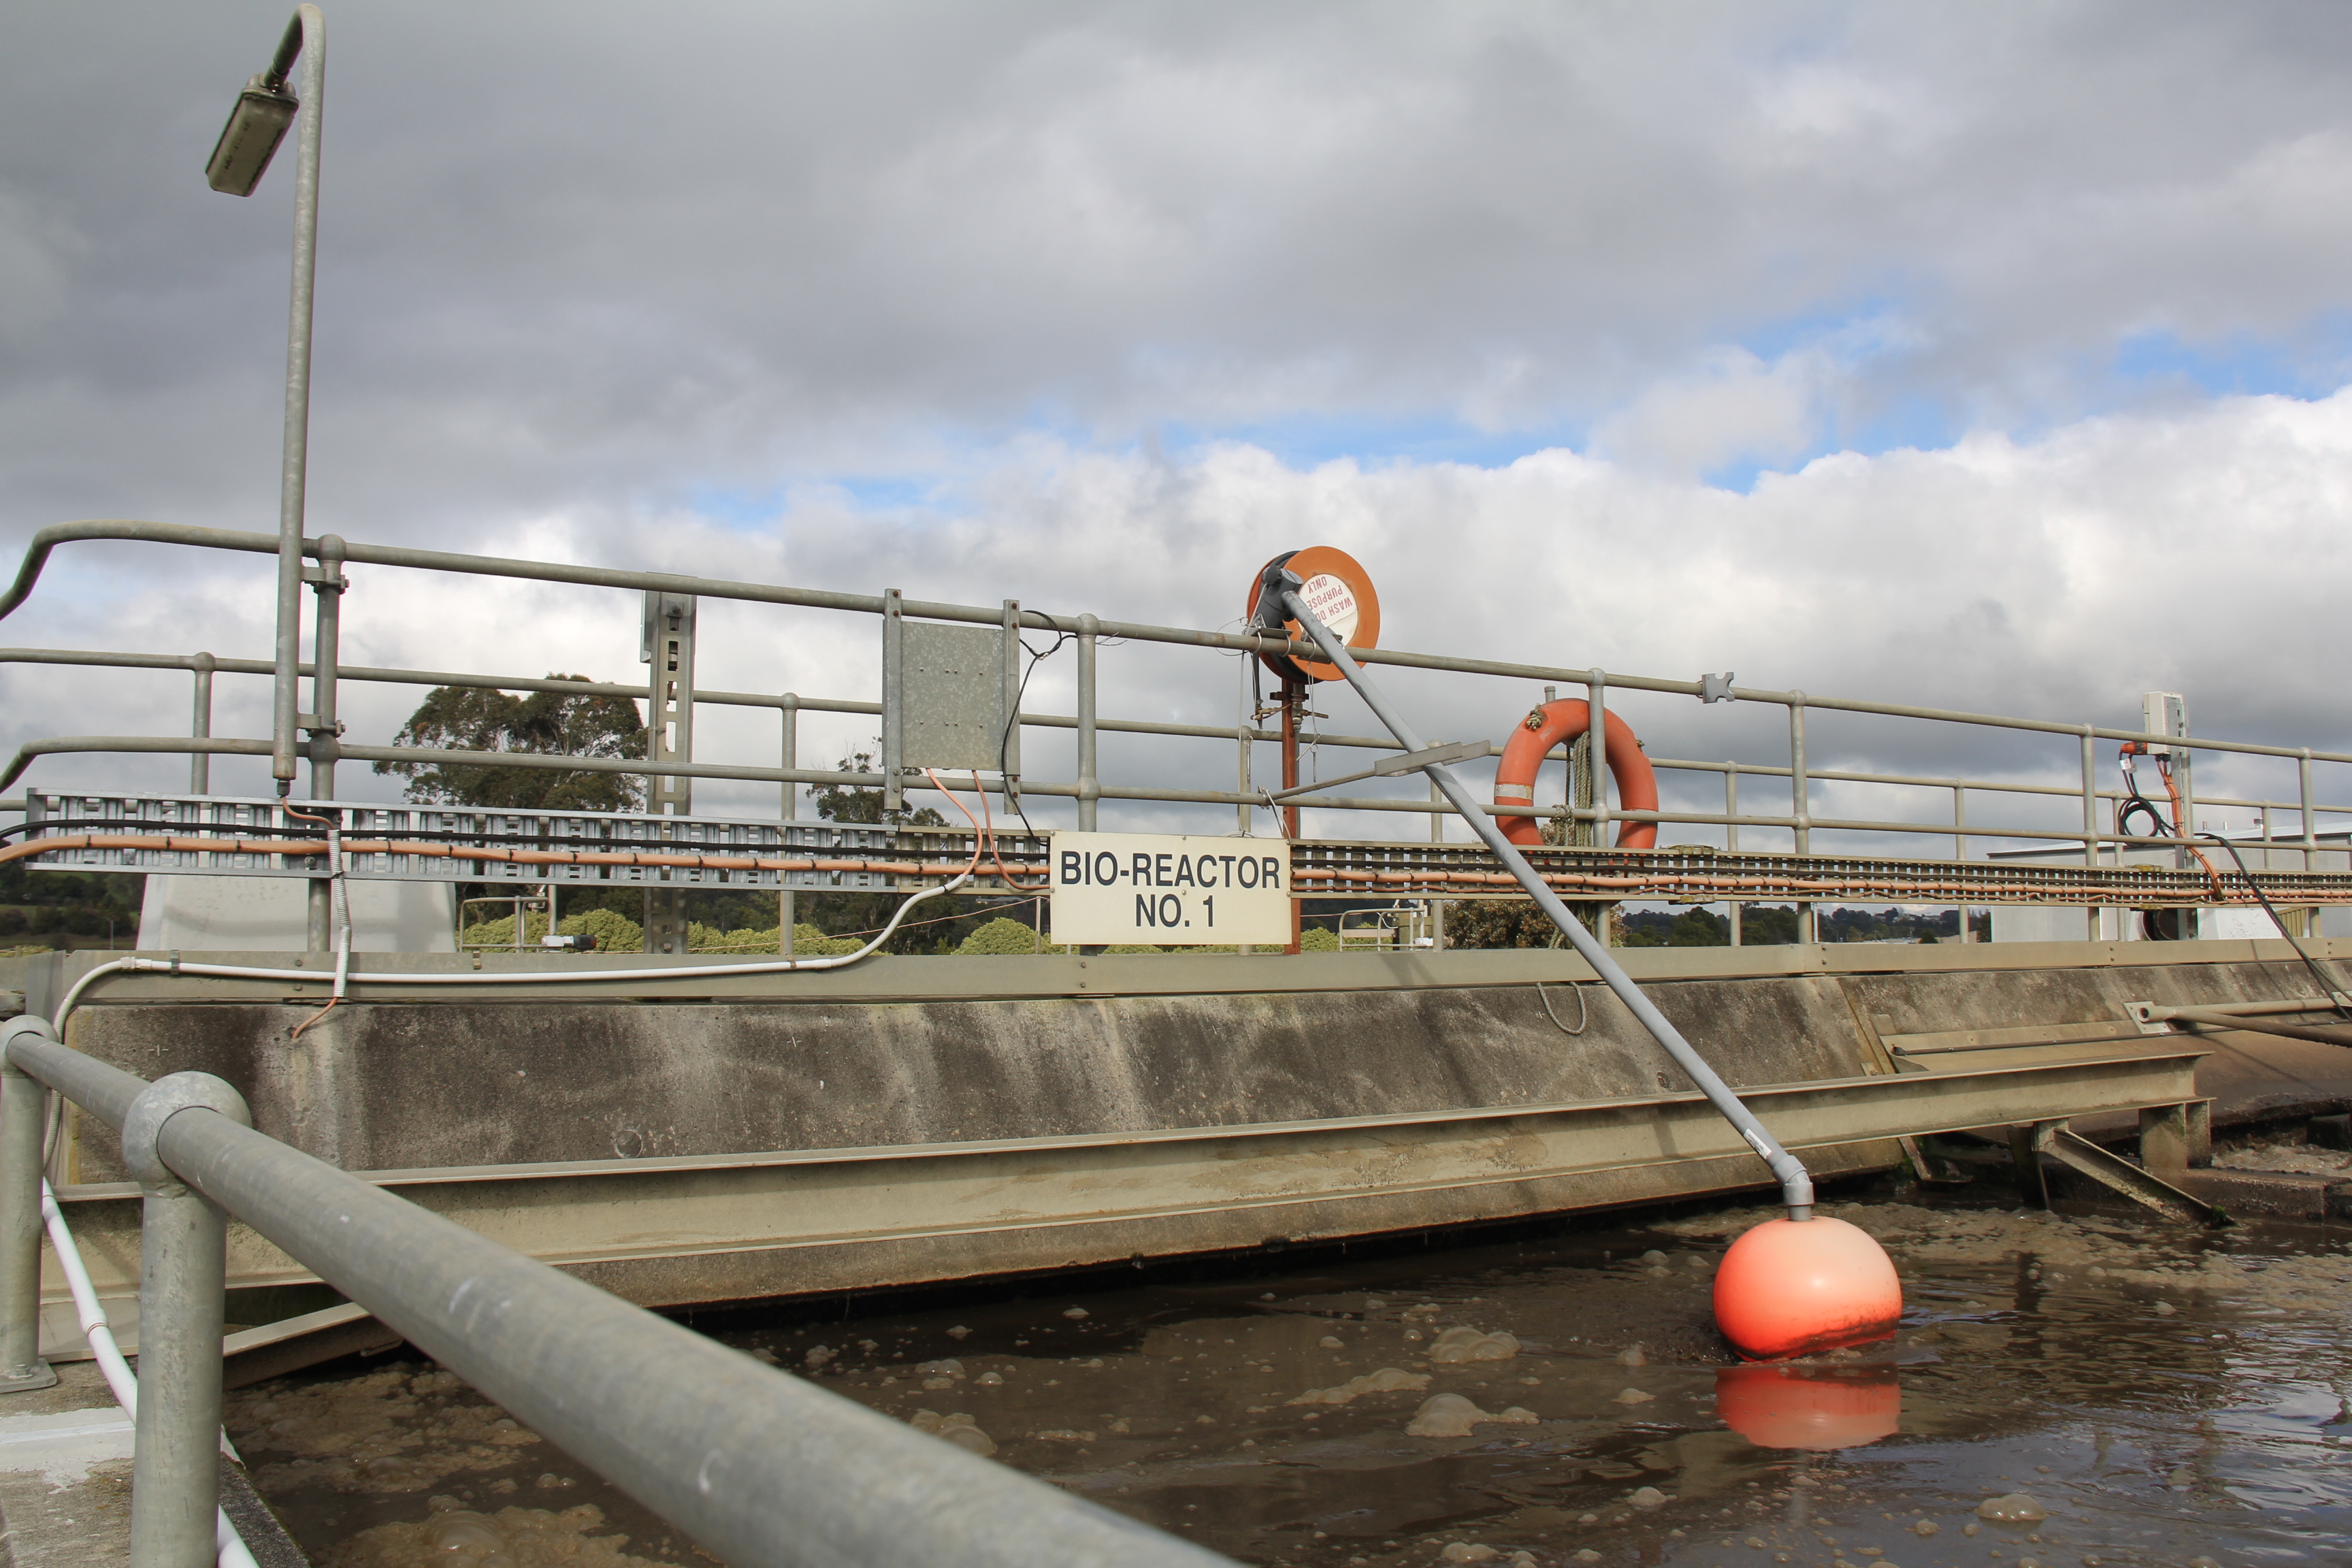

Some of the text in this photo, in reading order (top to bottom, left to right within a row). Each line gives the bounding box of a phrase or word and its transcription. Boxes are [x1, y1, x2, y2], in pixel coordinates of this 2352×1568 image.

[1307, 576, 1328, 594] ONLY
[1307, 585, 1343, 610] PURPOSE
[1315, 597, 1353, 621] WASH DO
[1060, 851, 1280, 889] BIO-REACTOR
[1136, 894, 1213, 927] NO. 1
